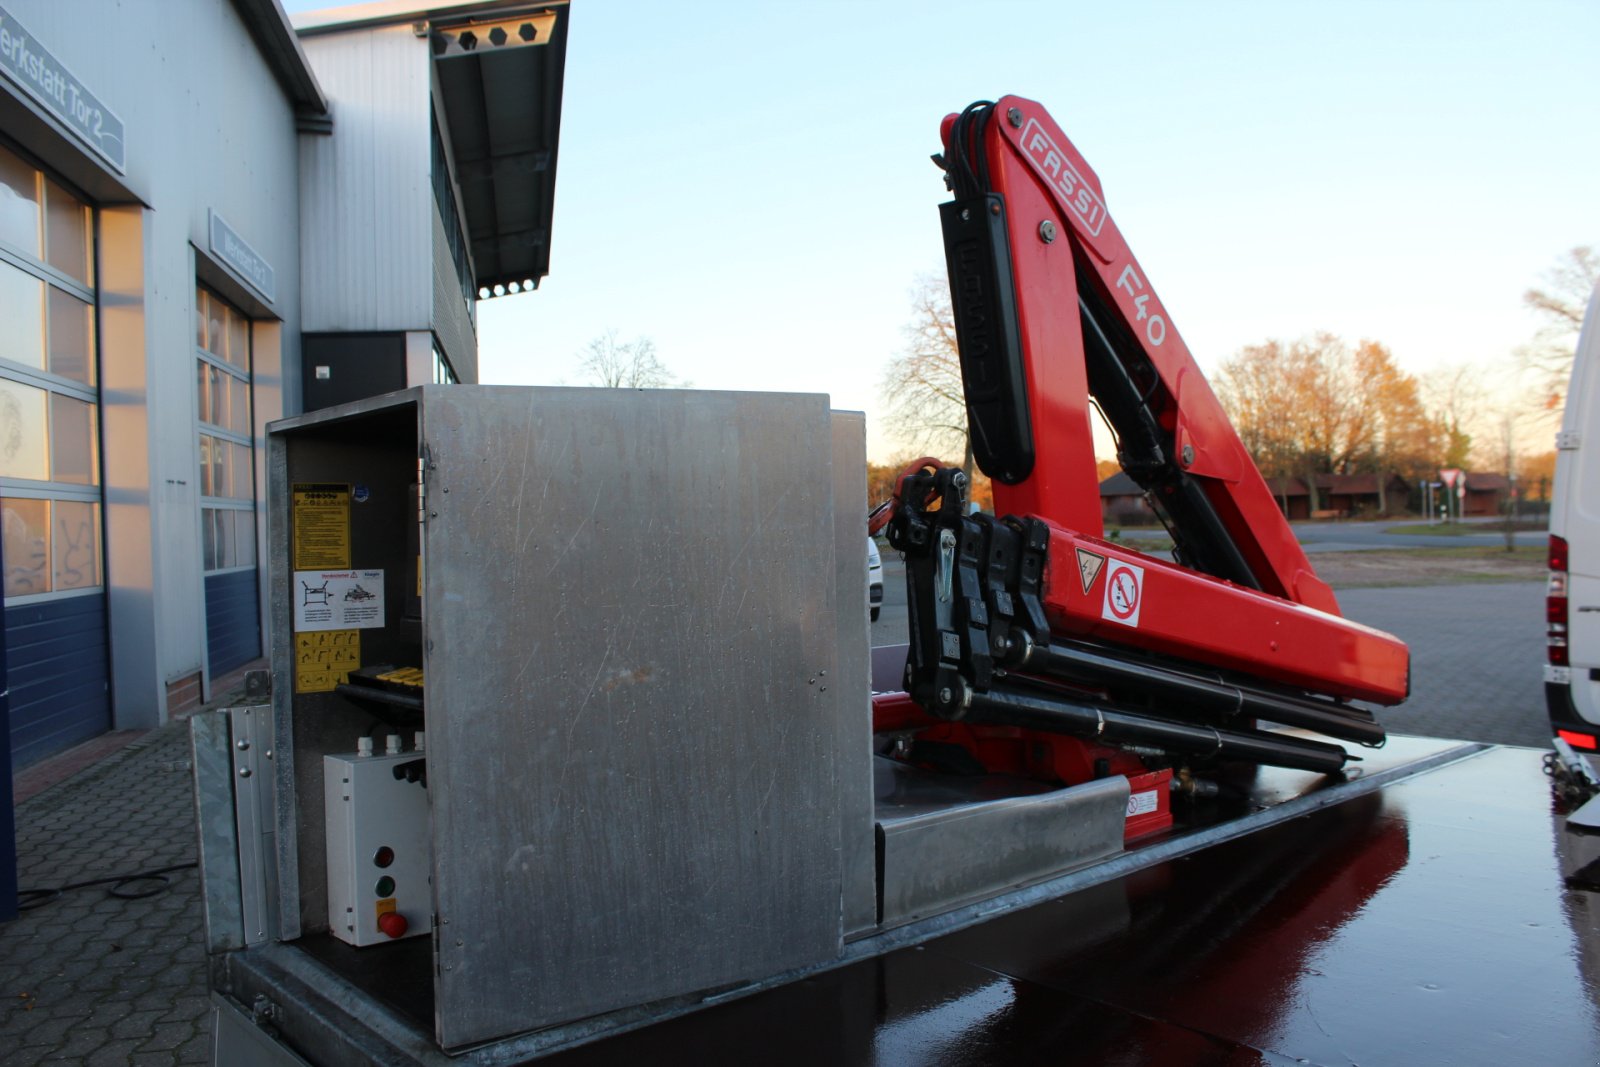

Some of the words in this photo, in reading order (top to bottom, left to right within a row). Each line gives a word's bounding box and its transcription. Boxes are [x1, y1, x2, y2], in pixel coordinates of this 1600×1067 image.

[0, 16, 66, 107] erkstatt
[69, 83, 93, 128] Tor
[93, 109, 103, 139] 2
[1029, 133, 1099, 225] FASSI
